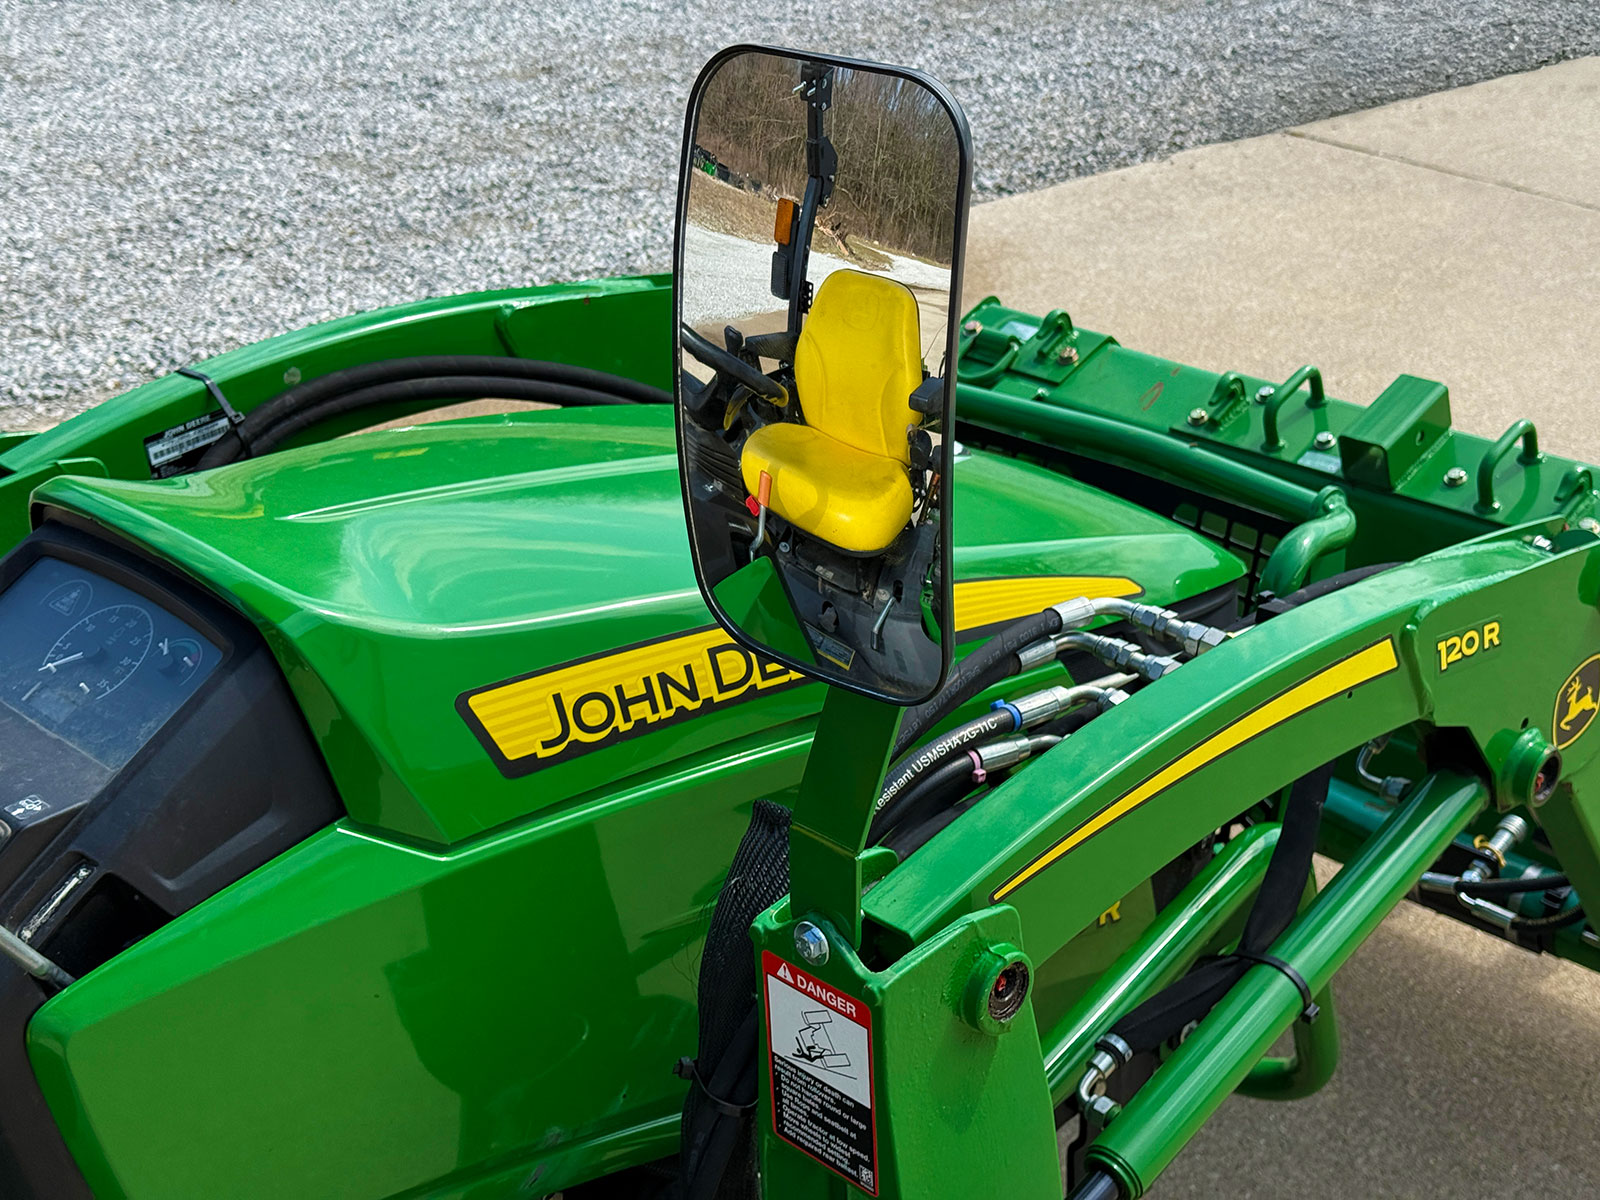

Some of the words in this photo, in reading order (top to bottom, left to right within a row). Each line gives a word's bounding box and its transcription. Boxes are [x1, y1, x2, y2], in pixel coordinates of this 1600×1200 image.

[541, 664, 700, 750] JOHN
[911, 736, 963, 773] USMSHA
[960, 717, 998, 743] 2G-11C
[797, 974, 857, 1018] DANGER
[774, 1063, 791, 1077] result
[791, 1073, 806, 1087] from
[781, 1082, 801, 1098] square
[781, 1088, 793, 1100] Use
[811, 1108, 822, 1119] and
[790, 1080, 800, 1090] not
[801, 1086, 821, 1103] handle
[822, 1100, 841, 1115] round
[850, 1115, 866, 1130] large
[823, 1086, 841, 1100] death
[842, 1097, 854, 1107] can
[782, 1104, 806, 1123] Operate
[807, 1119, 827, 1135] tractor
[836, 1137, 848, 1148] low
[848, 1146, 869, 1162] speed.
[782, 1111, 799, 1125] Move
[800, 1123, 821, 1139] wheels
[829, 1141, 850, 1158] widest
[783, 1119, 826, 1149] recommended
[783, 1126, 796, 1138] Add
[796, 1135, 821, 1154] required
[822, 1151, 835, 1162] rear
